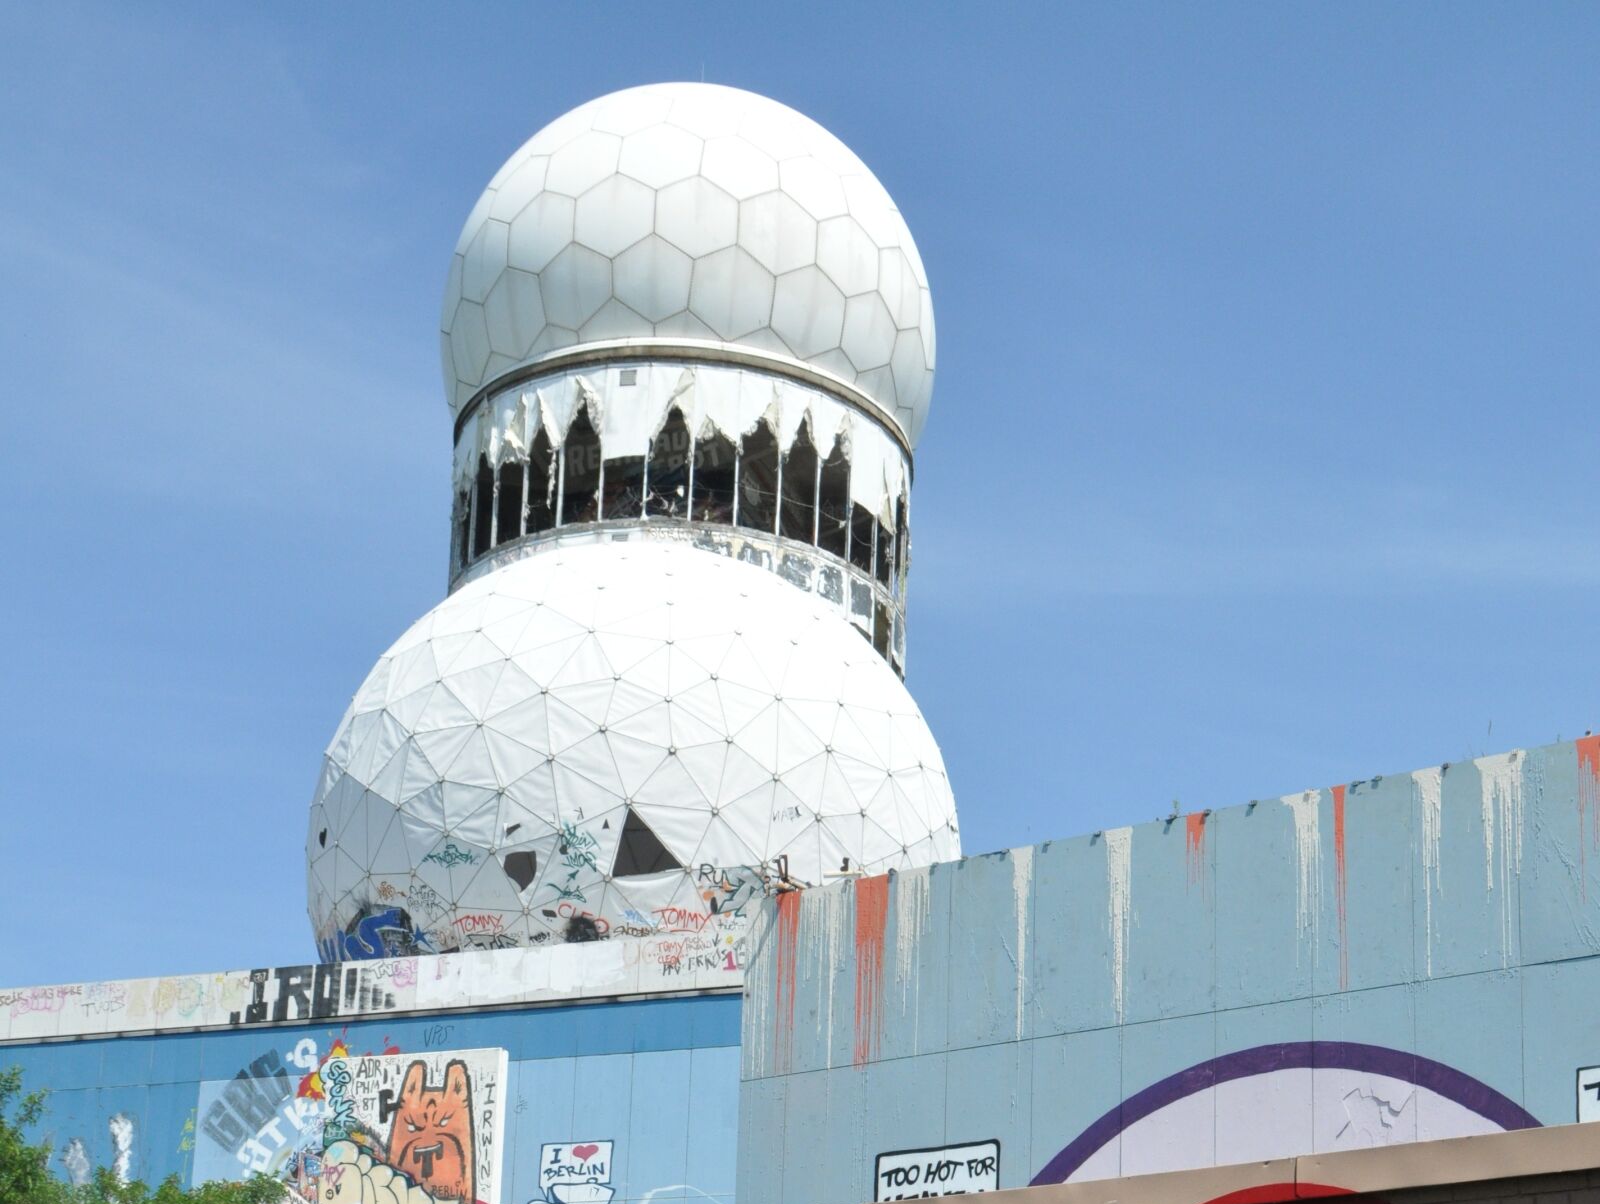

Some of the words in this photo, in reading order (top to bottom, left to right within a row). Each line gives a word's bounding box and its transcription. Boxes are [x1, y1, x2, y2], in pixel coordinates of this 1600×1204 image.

[451, 914, 502, 934] TOMMY
[652, 907, 713, 933] TOMMY
[481, 1082, 498, 1178] IRWIN
[550, 1148, 562, 1164] I
[543, 1162, 605, 1180] BERLIN
[881, 1164, 920, 1188] TOO
[924, 1160, 964, 1184] HOT
[966, 1156, 996, 1178] FOR
